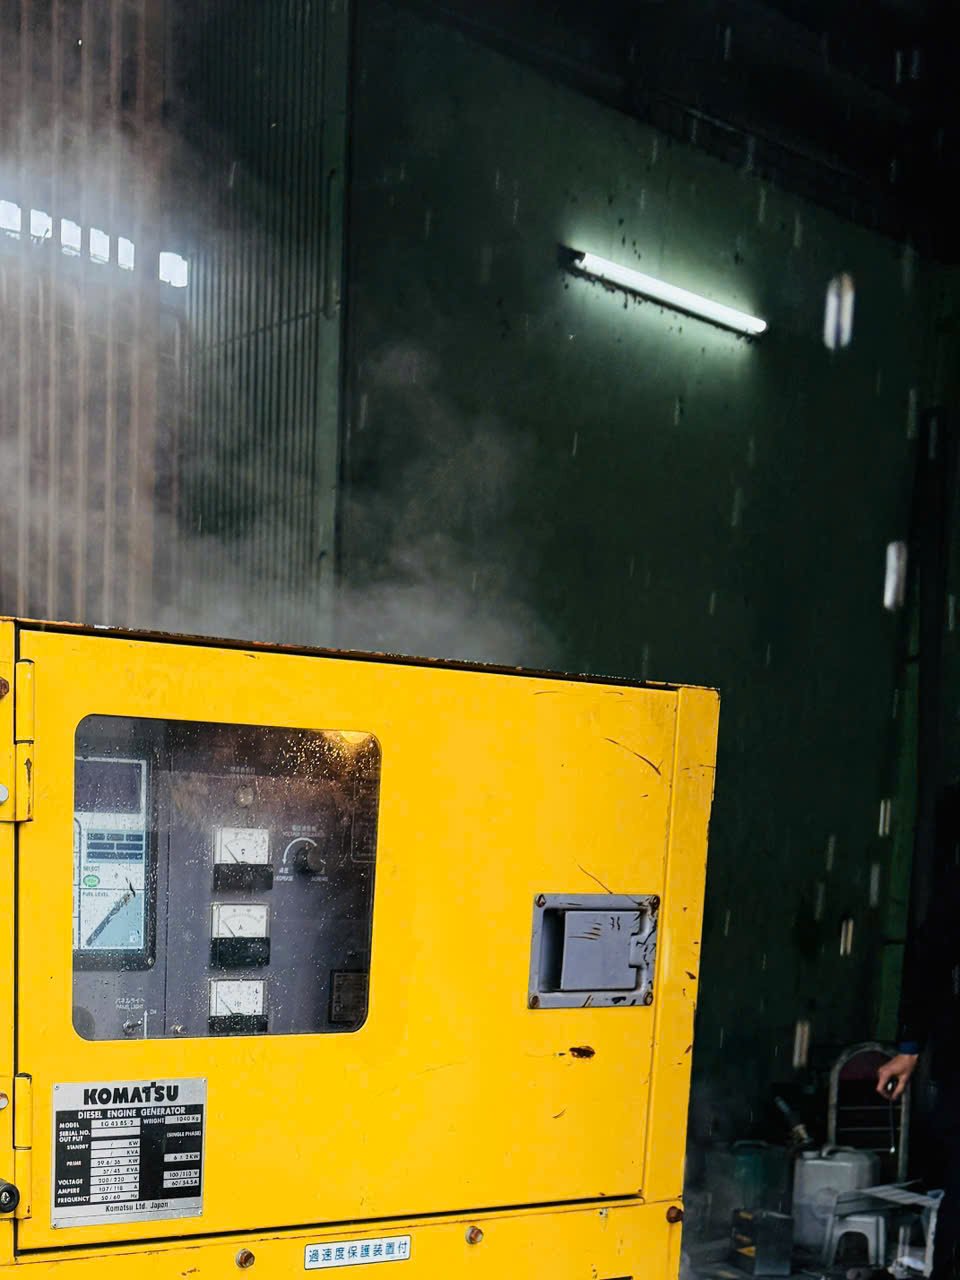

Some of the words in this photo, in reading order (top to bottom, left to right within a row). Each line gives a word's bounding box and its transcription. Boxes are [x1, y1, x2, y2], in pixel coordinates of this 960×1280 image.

[83, 1082, 179, 1105] KOMATSU
[78, 1111, 103, 1119] DIESEL
[107, 1109, 137, 1117] ENGINE
[141, 1107, 186, 1116] GENERATOR
[57, 1195, 90, 1203] FREQUENCY
[105, 1203, 134, 1213] Komatsu
[135, 1202, 148, 1210] Ltd.
[150, 1200, 169, 1210] Japan
[308, 1241, 408, 1263] 過速度保護装置付
